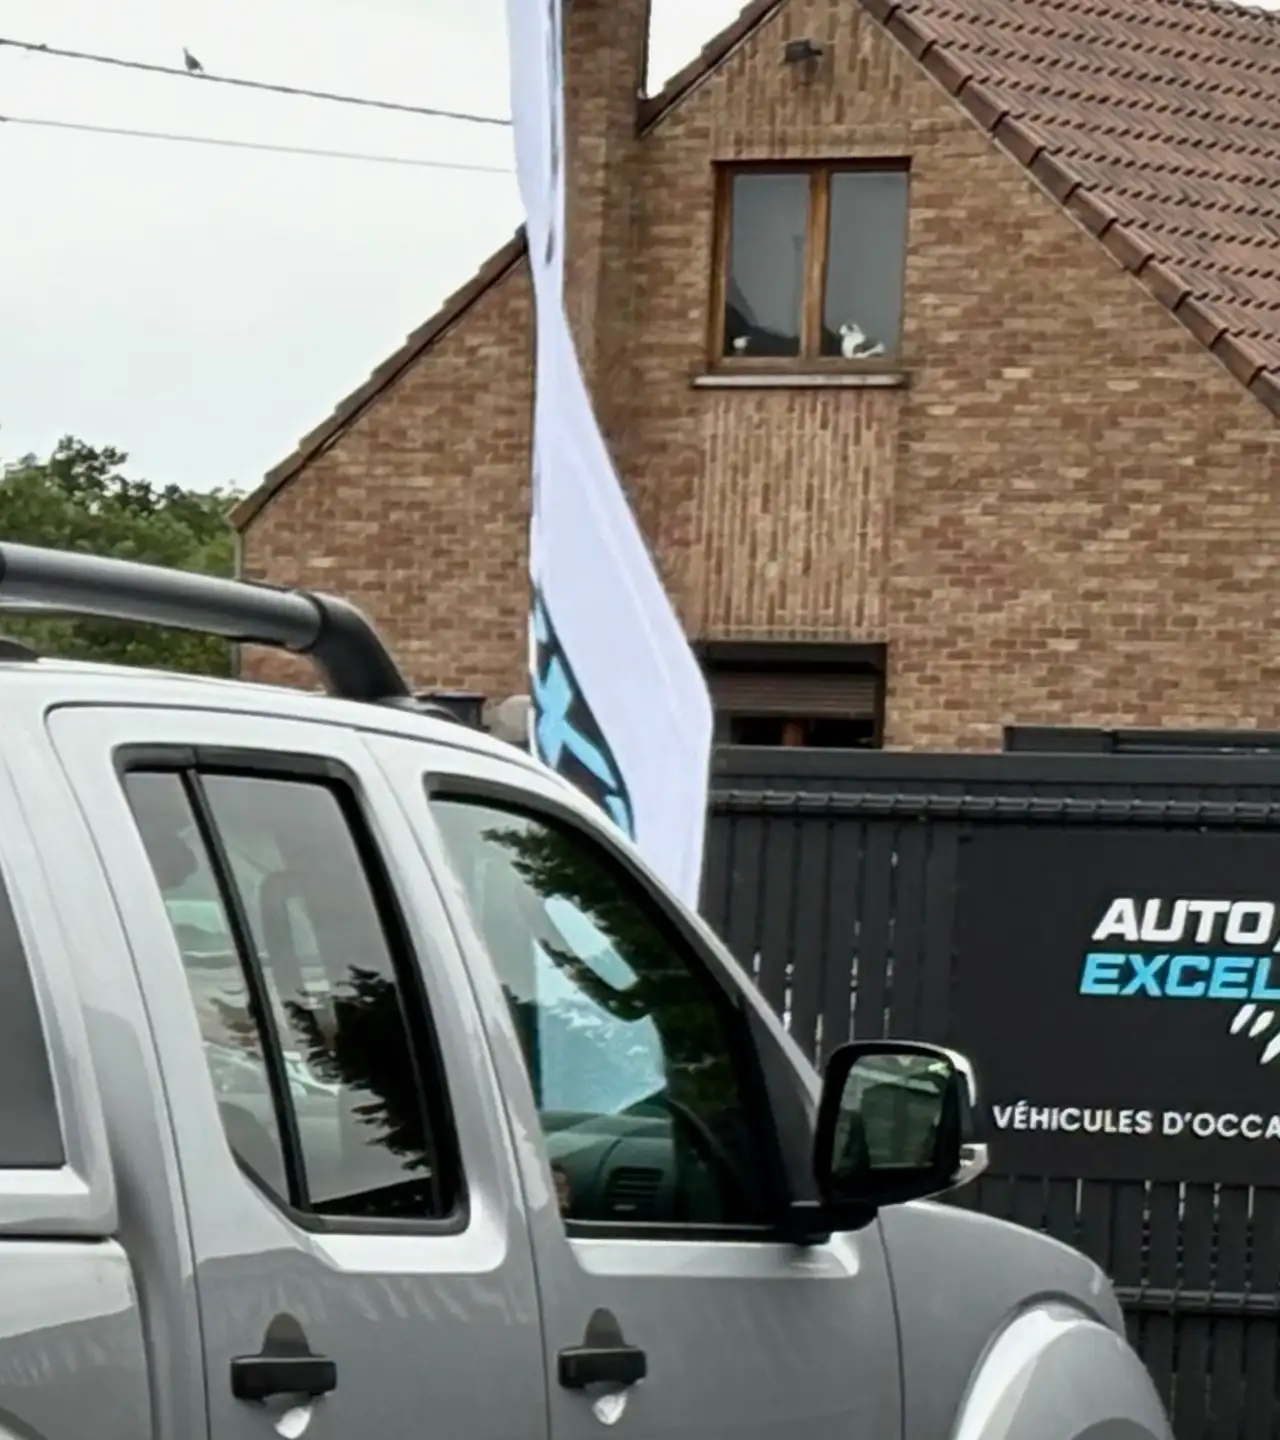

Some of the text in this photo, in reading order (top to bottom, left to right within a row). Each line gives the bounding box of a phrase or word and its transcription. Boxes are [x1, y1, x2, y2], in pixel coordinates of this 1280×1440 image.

[1091, 898, 1275, 945] AUTO
[1079, 952, 1280, 1000] EXCEL
[991, 1101, 1153, 1134] VÉHICULES
